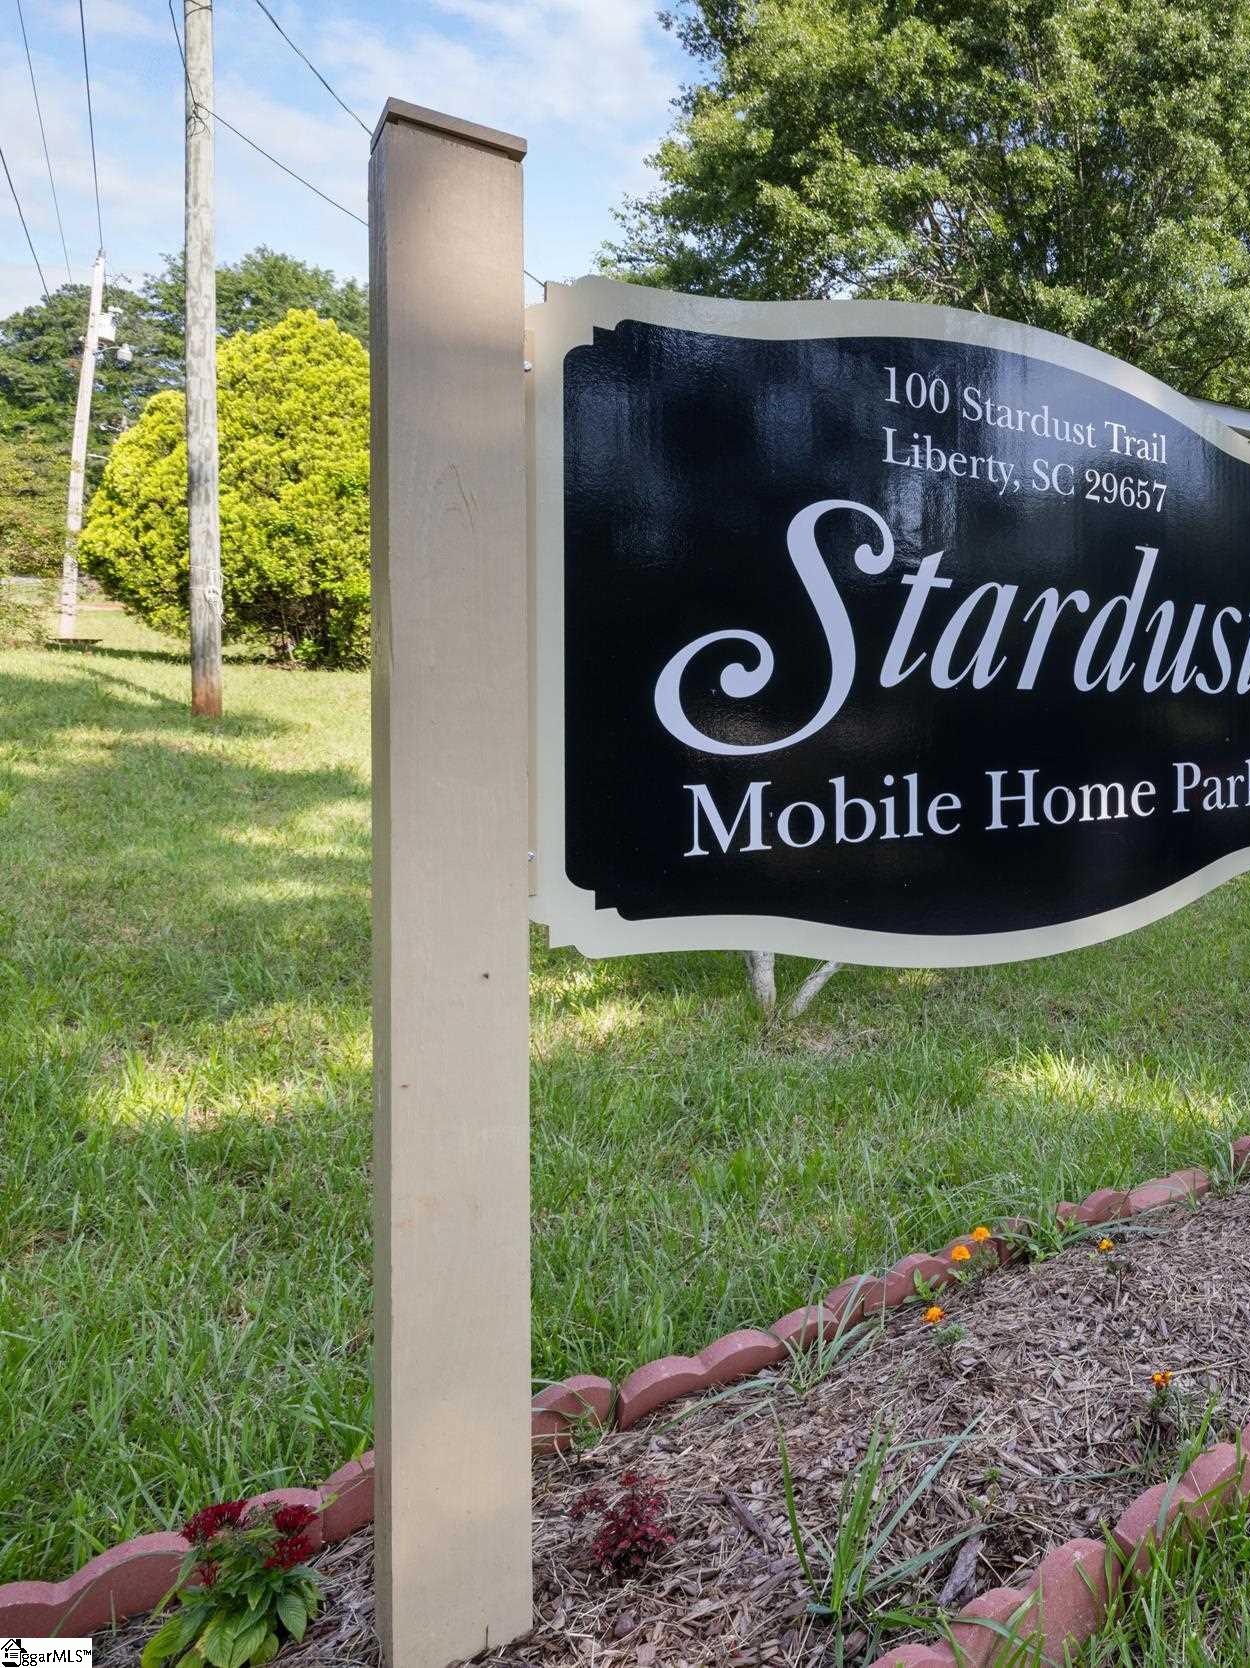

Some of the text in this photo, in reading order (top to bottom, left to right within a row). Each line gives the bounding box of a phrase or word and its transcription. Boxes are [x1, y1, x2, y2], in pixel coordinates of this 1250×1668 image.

[884, 366, 1167, 464] 100 Stardust Trail
[882, 426, 1168, 512] Liberty, SC 29657
[683, 774, 962, 857] Mobile
[985, 769, 1156, 830] Home
